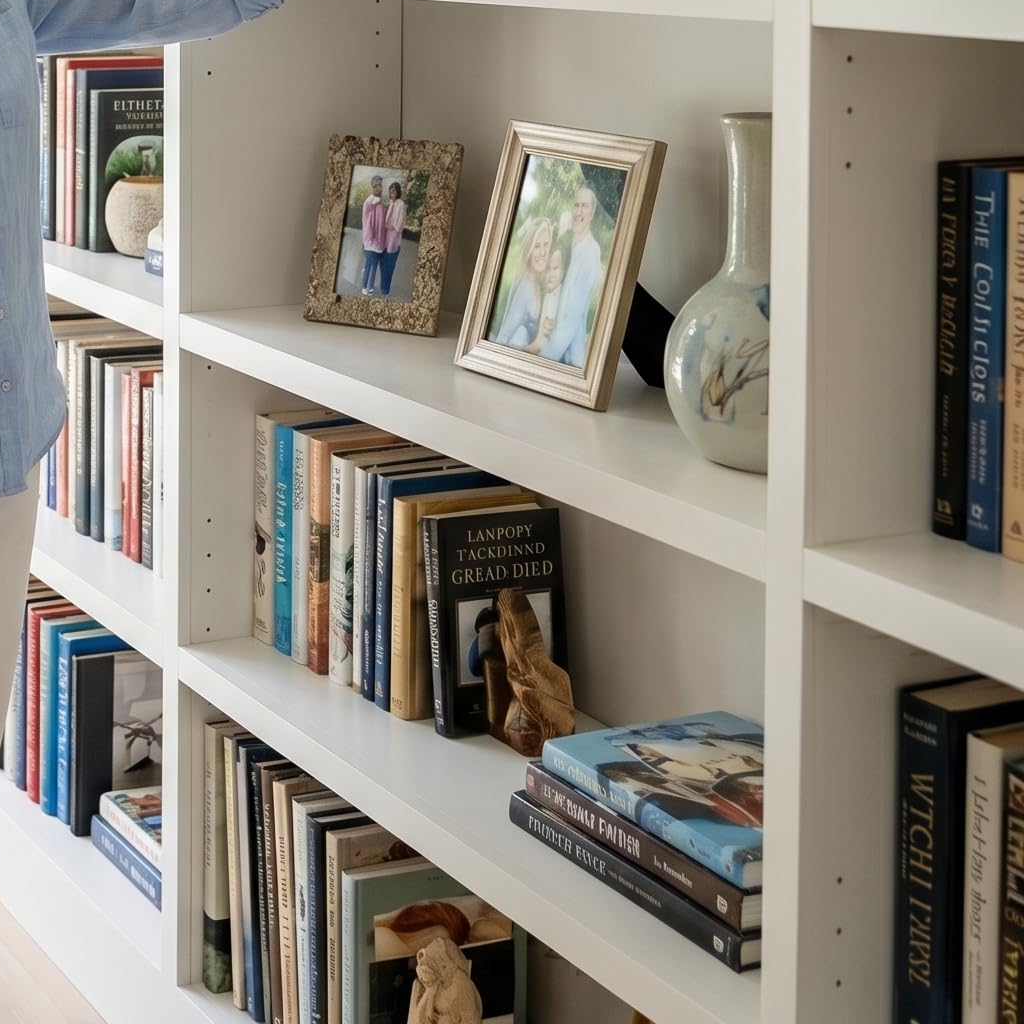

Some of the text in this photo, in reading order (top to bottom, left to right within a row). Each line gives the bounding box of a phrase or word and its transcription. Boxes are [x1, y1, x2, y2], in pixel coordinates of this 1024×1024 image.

[467, 524, 533, 543] LANPOPY
[451, 560, 553, 585] GREAD DIED
